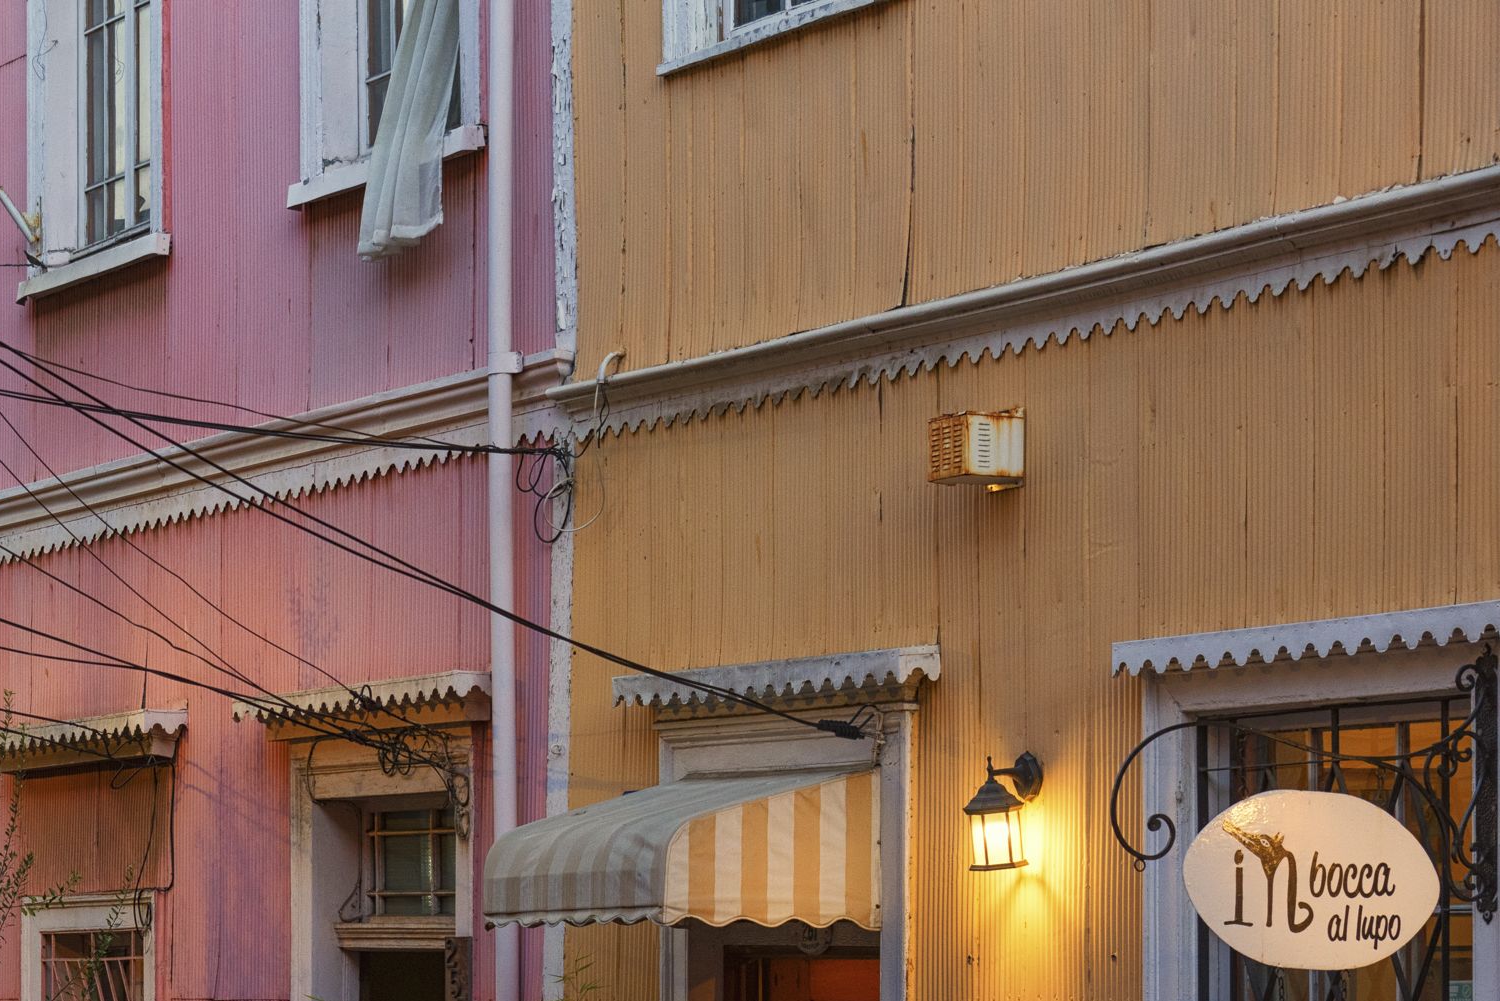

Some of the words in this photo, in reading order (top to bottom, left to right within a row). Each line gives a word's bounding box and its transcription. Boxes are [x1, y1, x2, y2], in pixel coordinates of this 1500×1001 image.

[1310, 851, 1396, 898] bocca
[1327, 905, 1350, 942] al
[1356, 905, 1401, 950] lupo
